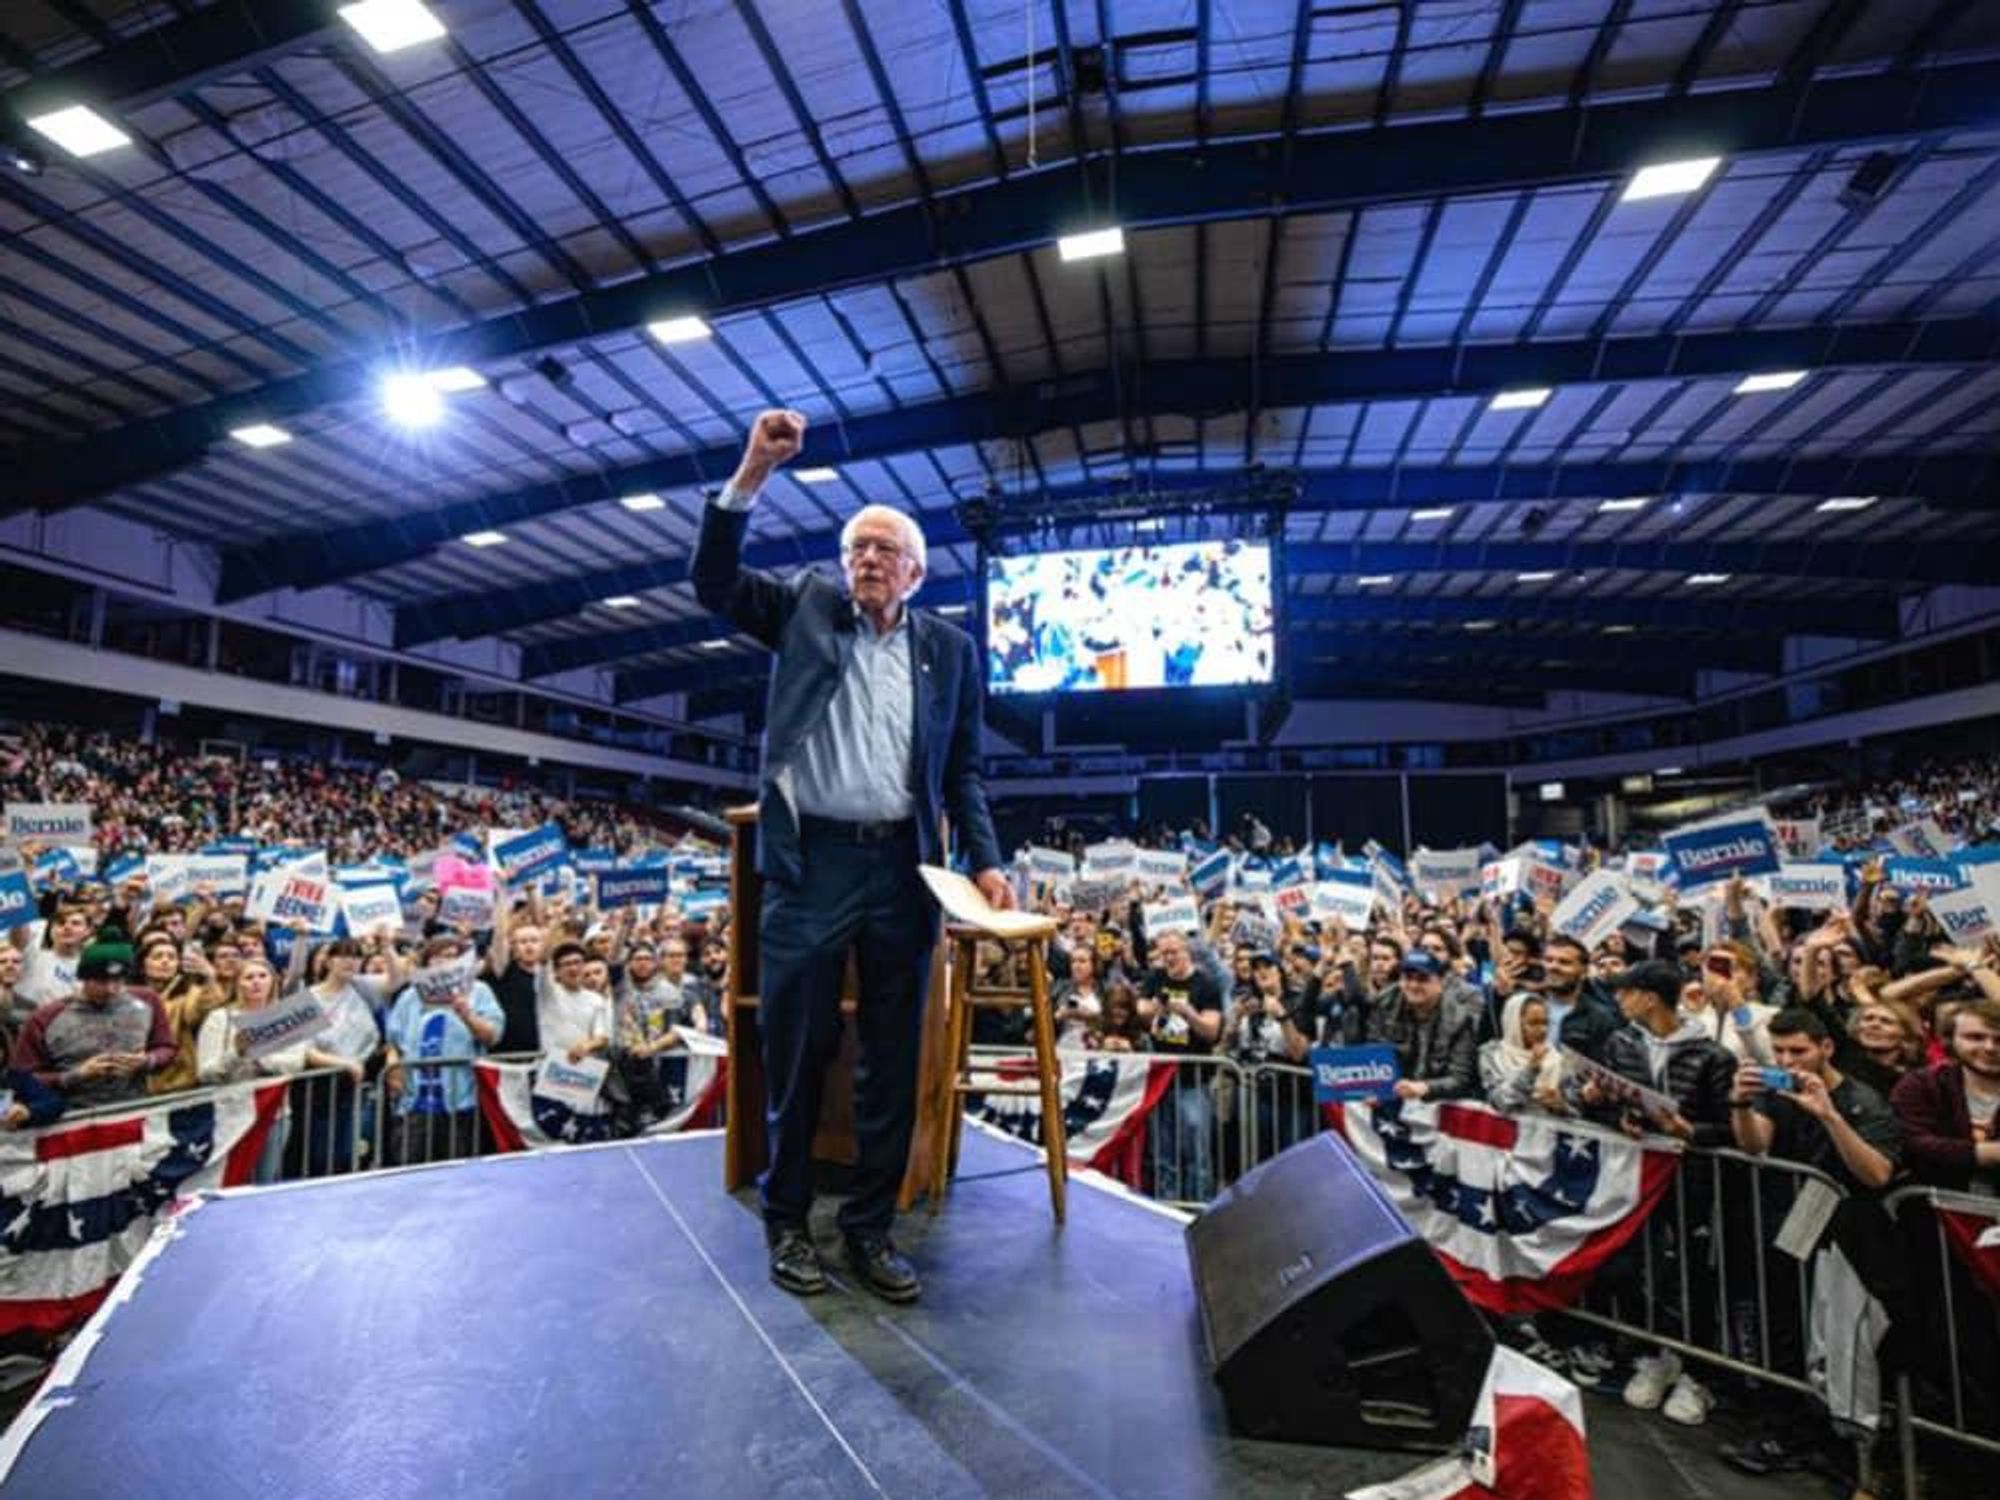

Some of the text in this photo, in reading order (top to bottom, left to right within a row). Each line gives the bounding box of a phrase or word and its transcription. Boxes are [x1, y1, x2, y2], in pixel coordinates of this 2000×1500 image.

[11, 816, 85, 833] Bernie
[1678, 838, 1767, 866] Bernie
[1770, 876, 1838, 894] Bernie
[1317, 1060, 1394, 1086] Bernie
